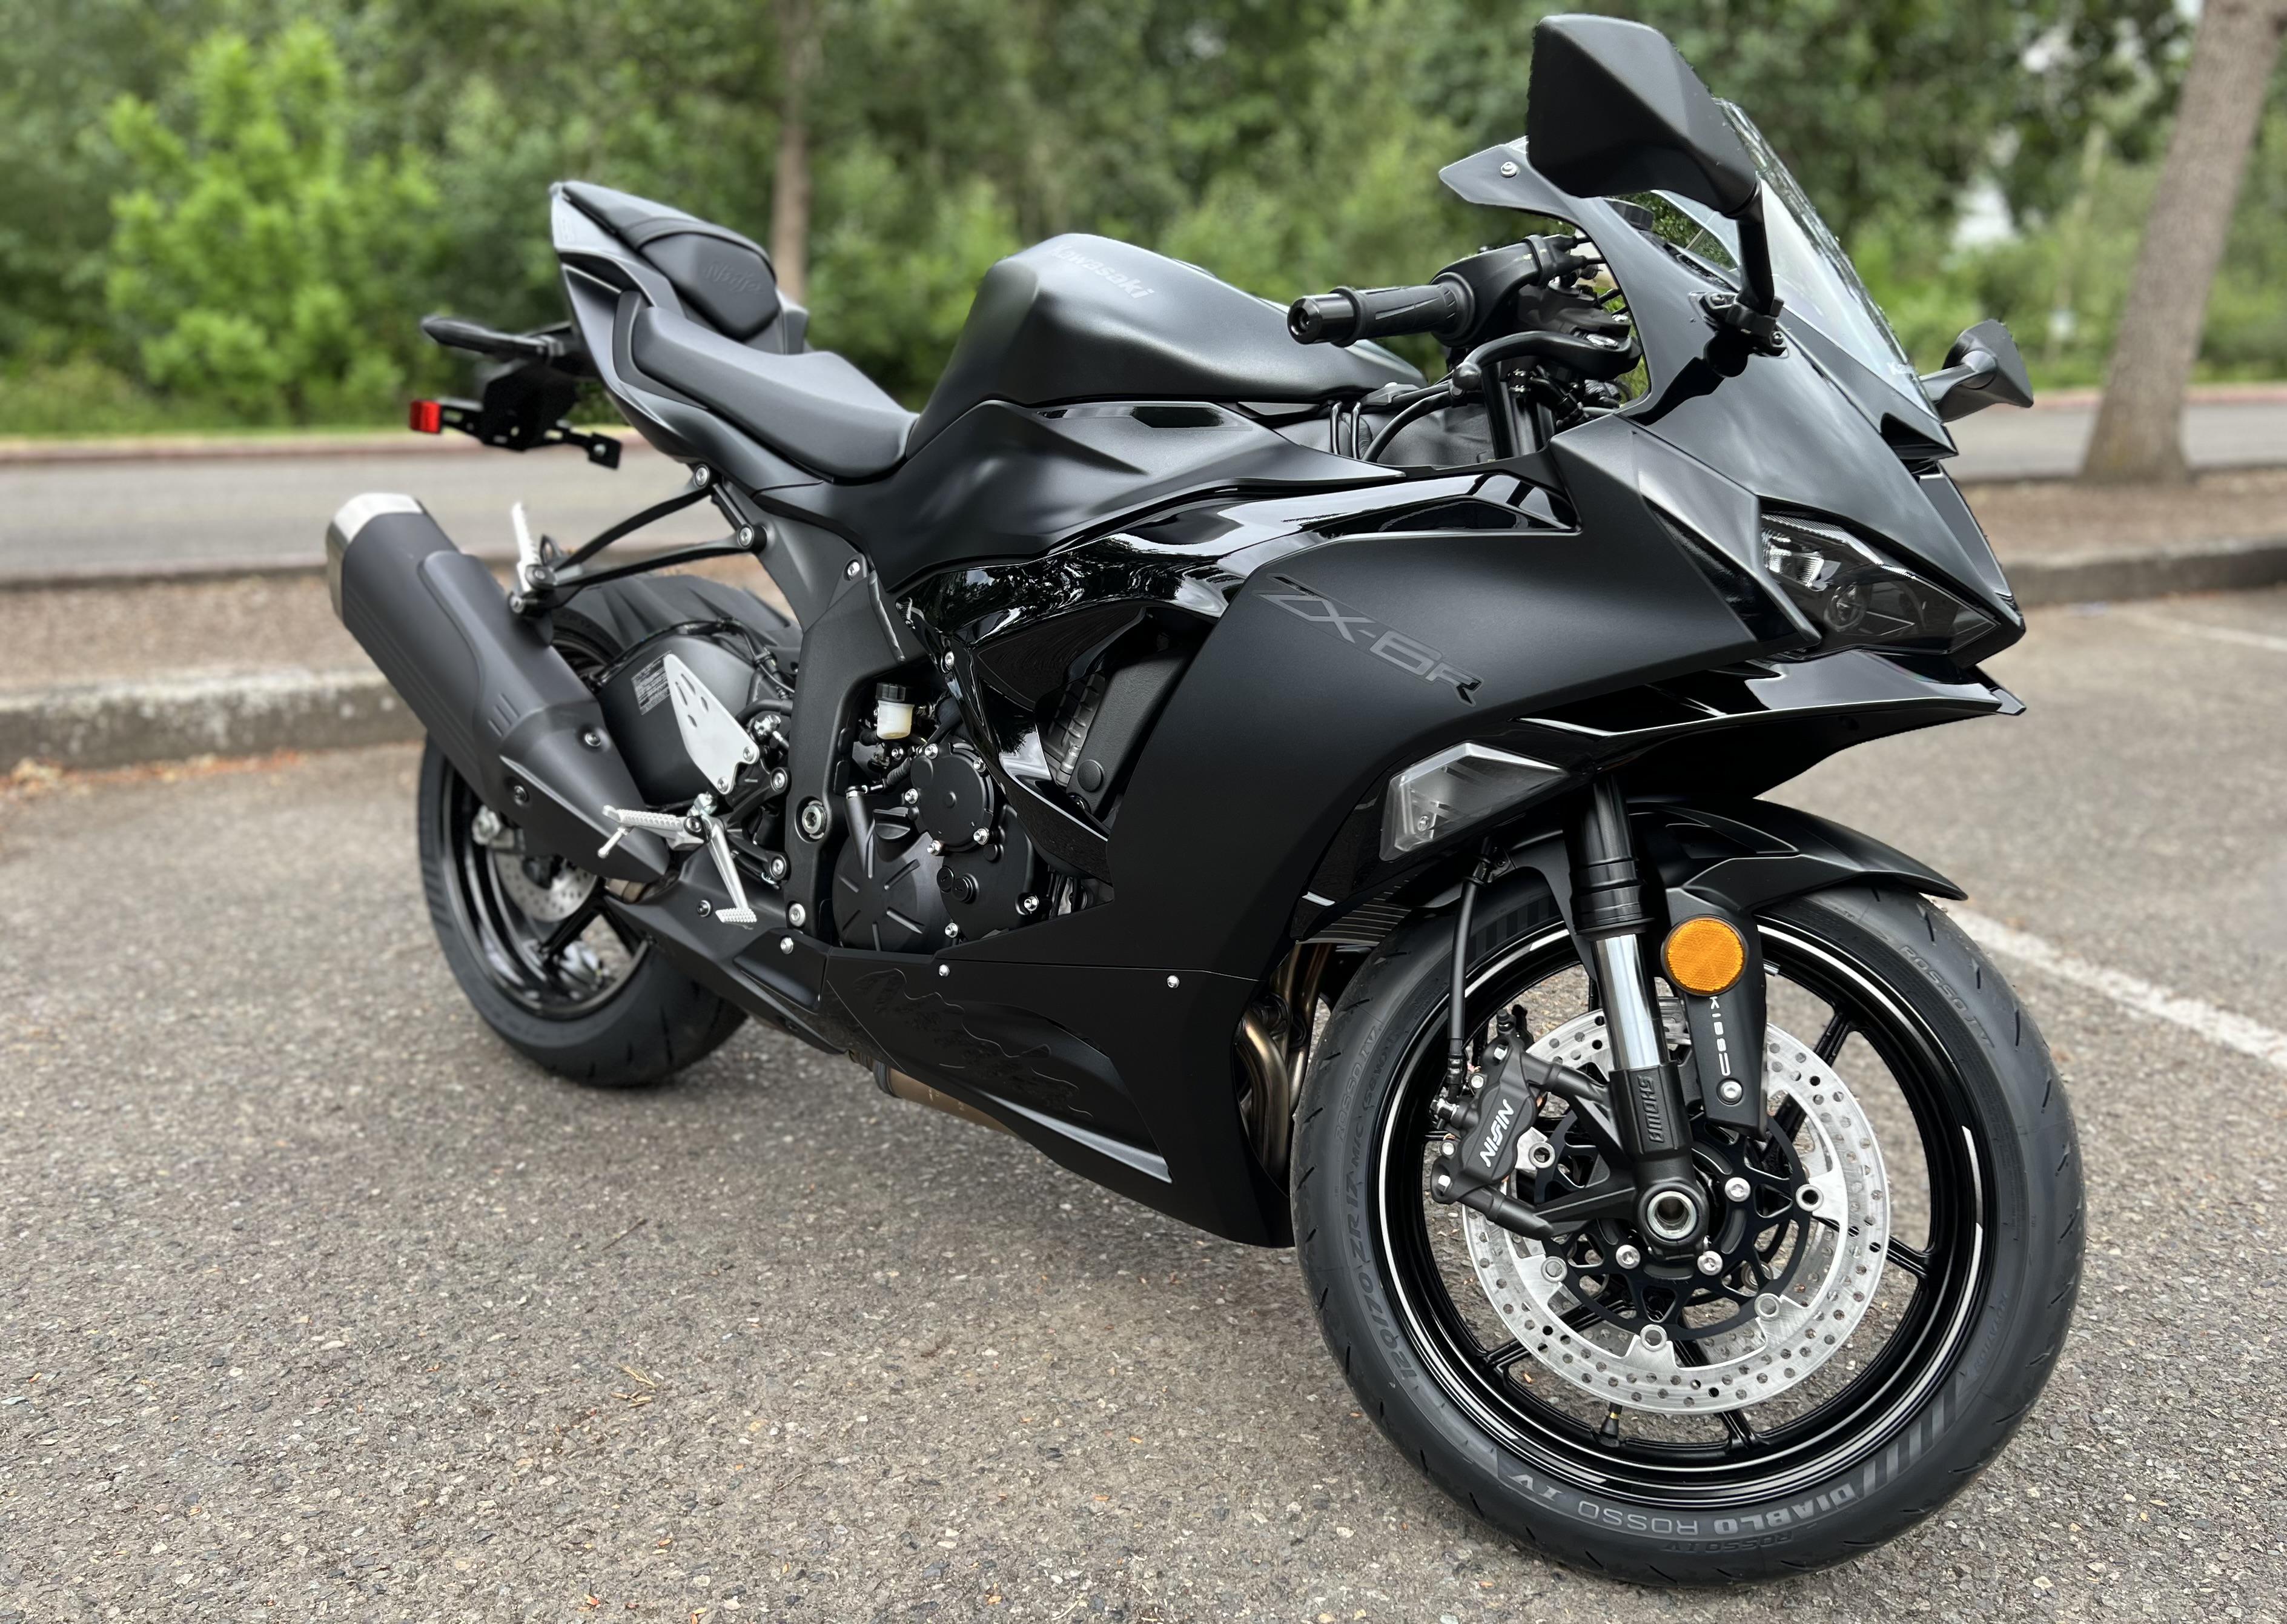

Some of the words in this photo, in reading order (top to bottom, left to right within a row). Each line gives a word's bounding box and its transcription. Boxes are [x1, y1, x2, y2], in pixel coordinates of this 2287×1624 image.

[1051, 244, 1155, 299] Kawasaki
[1254, 574, 1482, 706] ZX-6R
[1899, 945, 1968, 1011] ROSSO
[1964, 1016, 1995, 1048] IV
[1334, 1062, 1363, 1142] ROSSO
[1637, 1075, 1665, 1144] SHOWA
[1508, 1473, 1563, 1502] IV
[1714, 1483, 1856, 1535] DIABLO
[1578, 1500, 1699, 1536] ROSSO
[1705, 1530, 1793, 1552] ROSSO
[1664, 1540, 1703, 1553] IV
